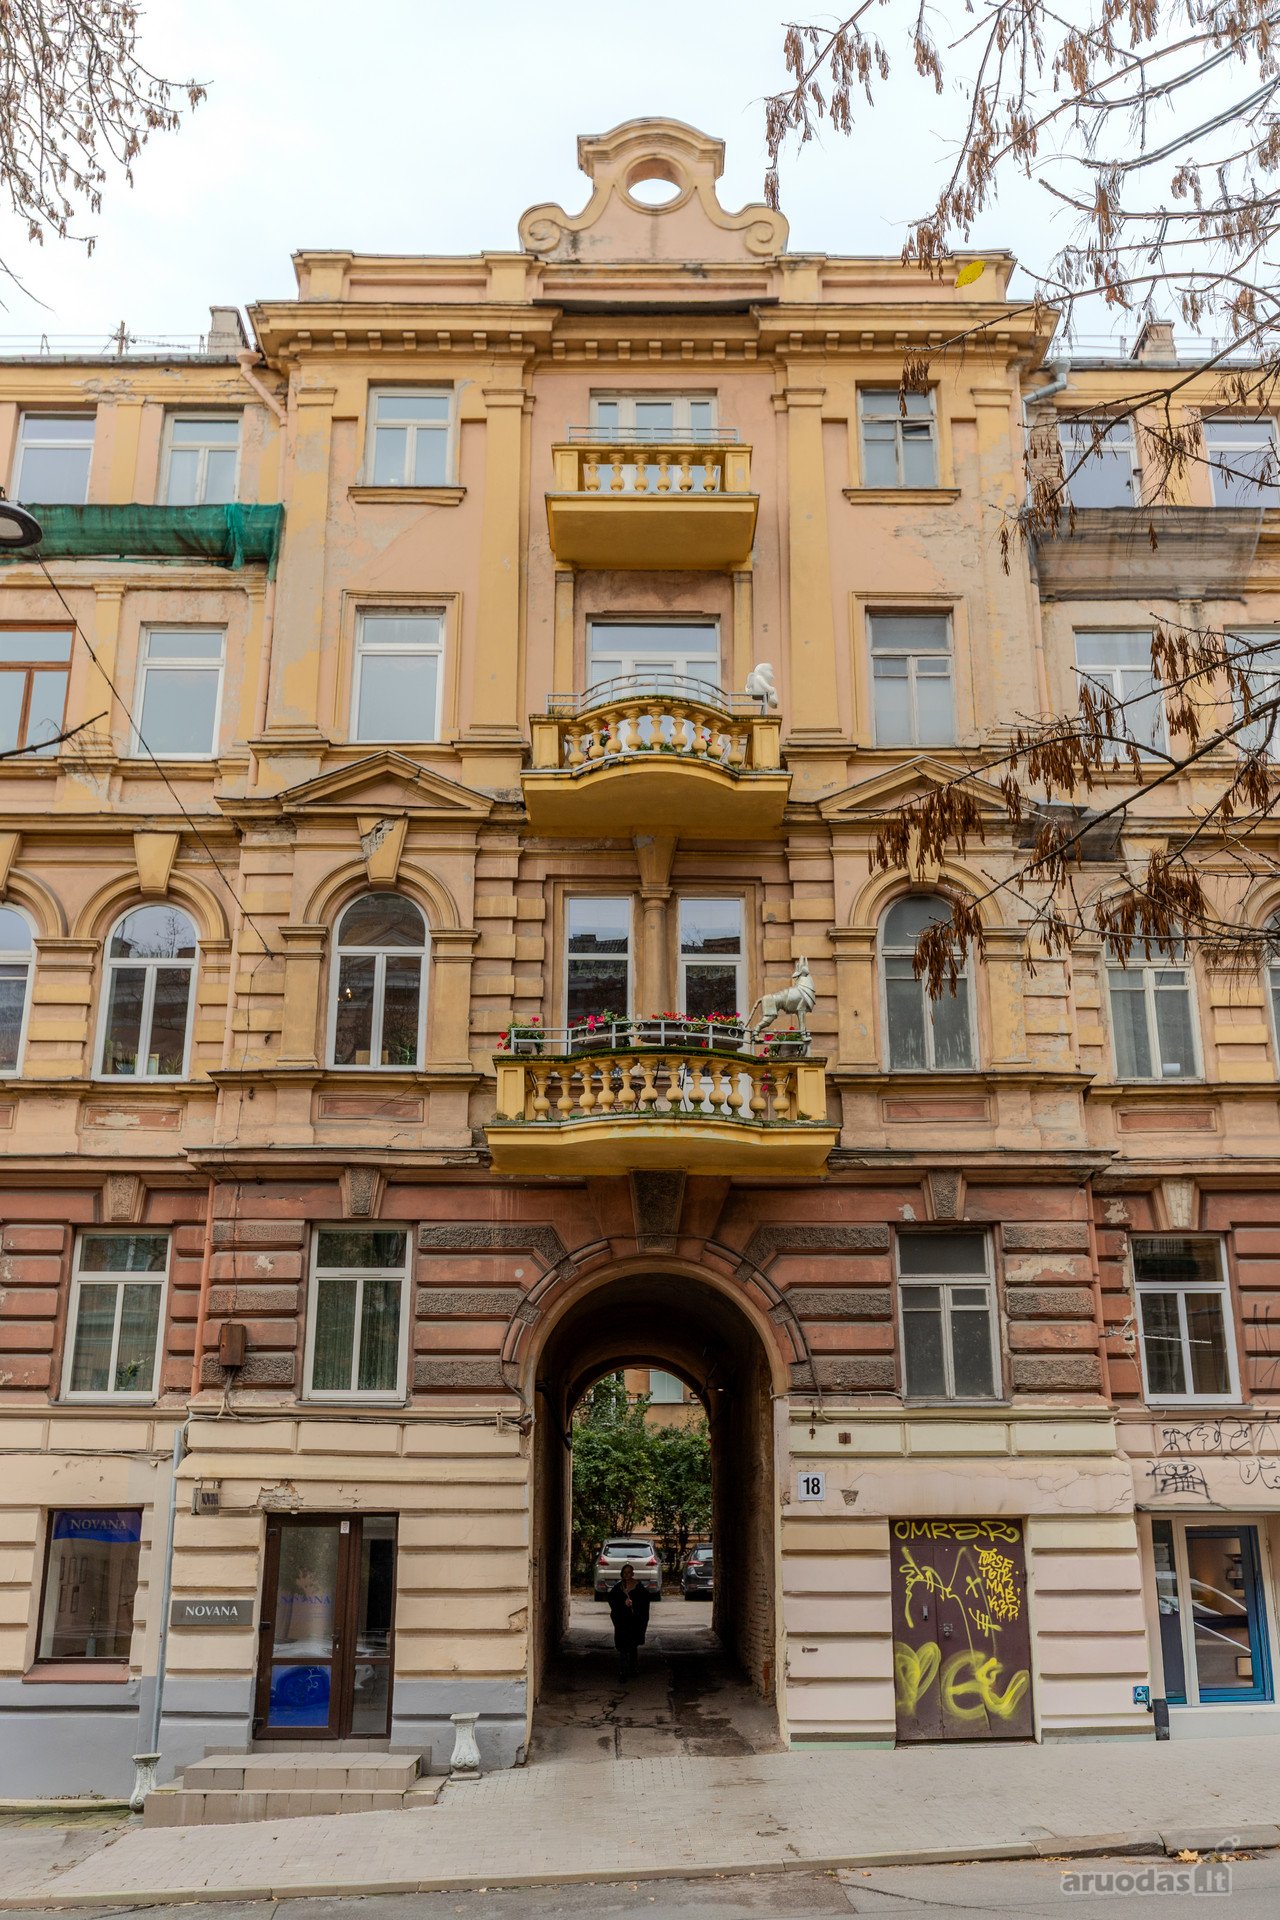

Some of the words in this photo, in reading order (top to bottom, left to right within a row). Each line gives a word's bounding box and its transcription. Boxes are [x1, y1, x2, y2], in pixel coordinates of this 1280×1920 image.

[803, 1477, 821, 1495] 18
[70, 1519, 127, 1530] NOVANA
[185, 1605, 238, 1617] NOVANA
